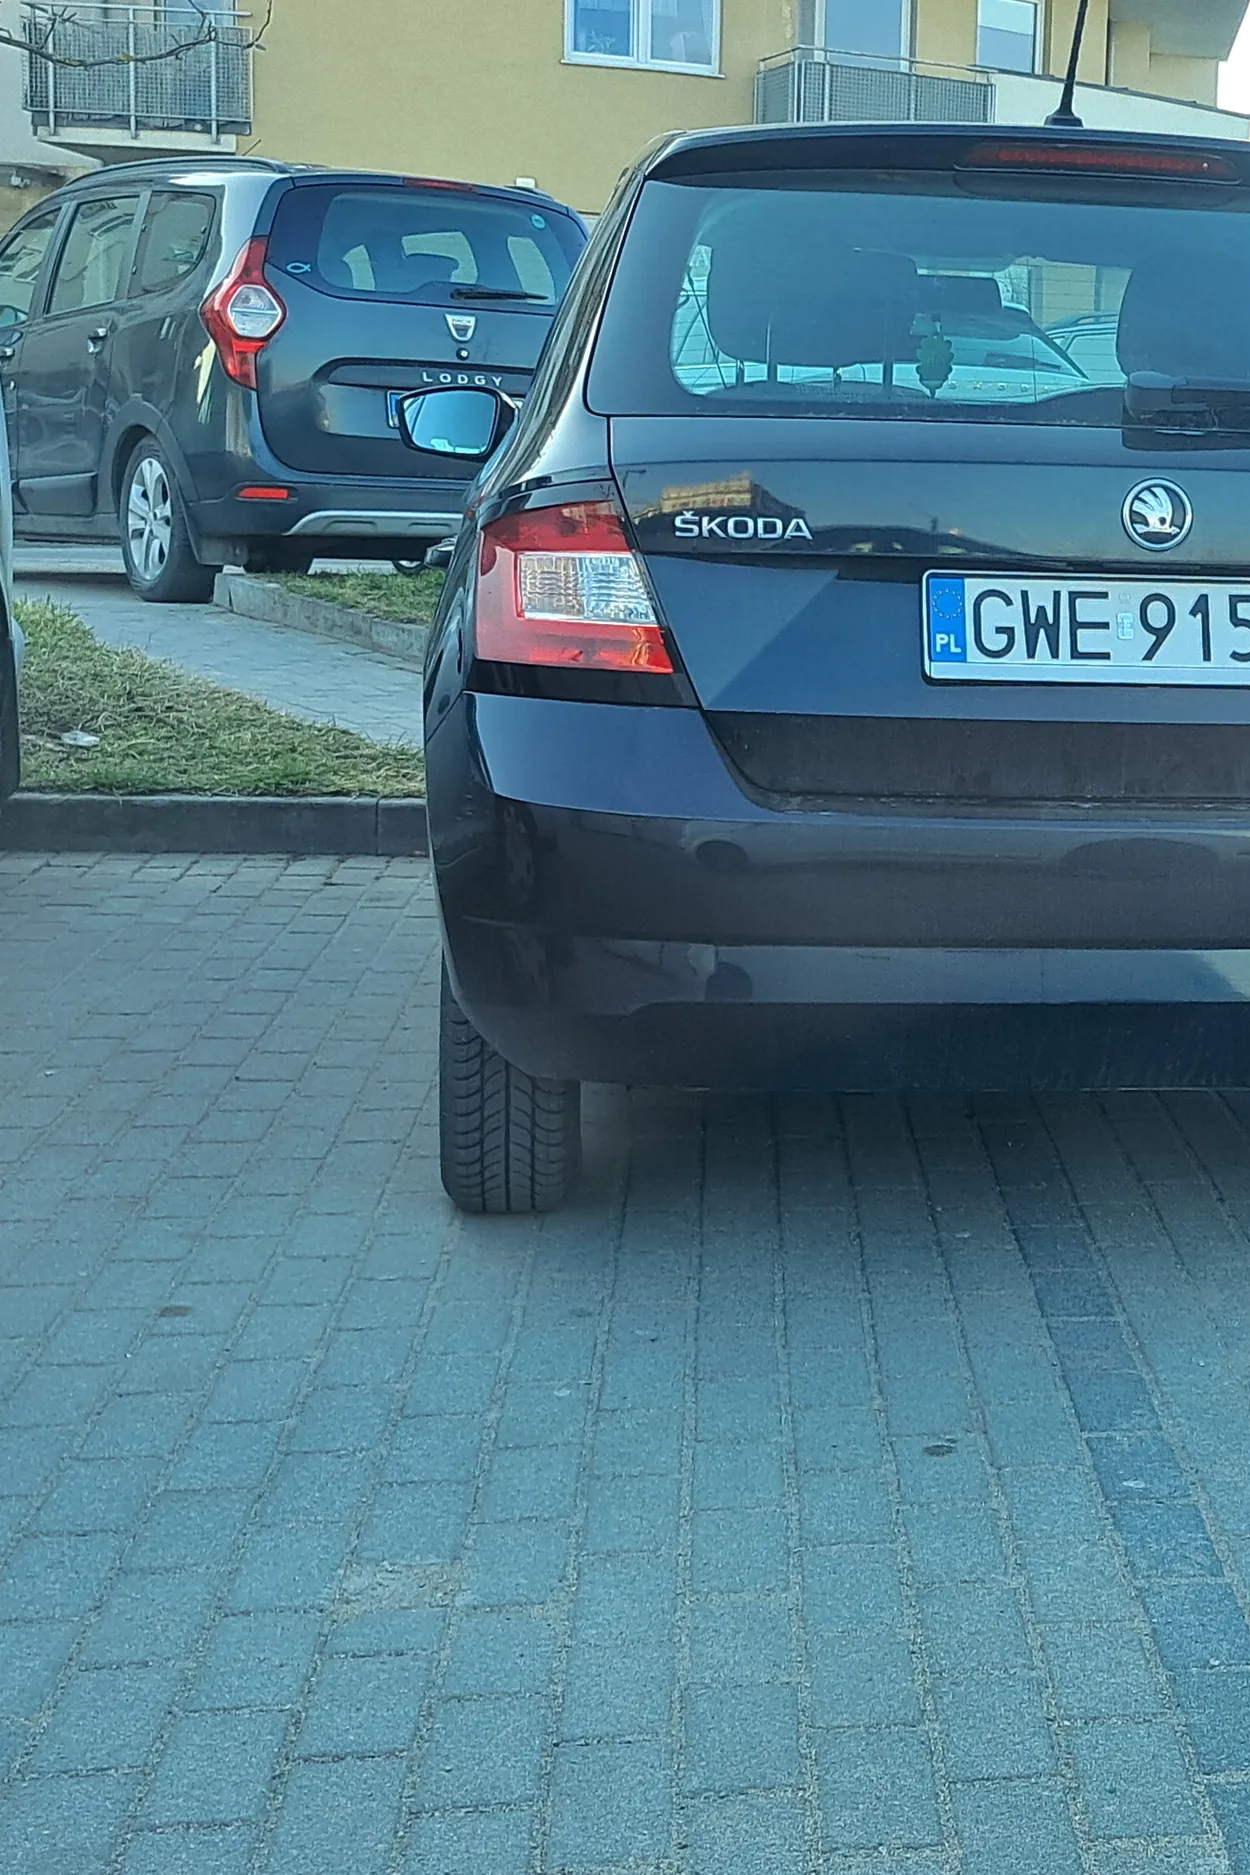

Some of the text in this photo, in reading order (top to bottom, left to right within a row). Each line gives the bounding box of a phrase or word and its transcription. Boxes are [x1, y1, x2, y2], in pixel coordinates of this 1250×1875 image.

[422, 371, 503, 387] LODGY
[674, 510, 814, 540] ŠKODA
[972, 589, 1111, 660] GWE
[935, 633, 962, 653] PL
